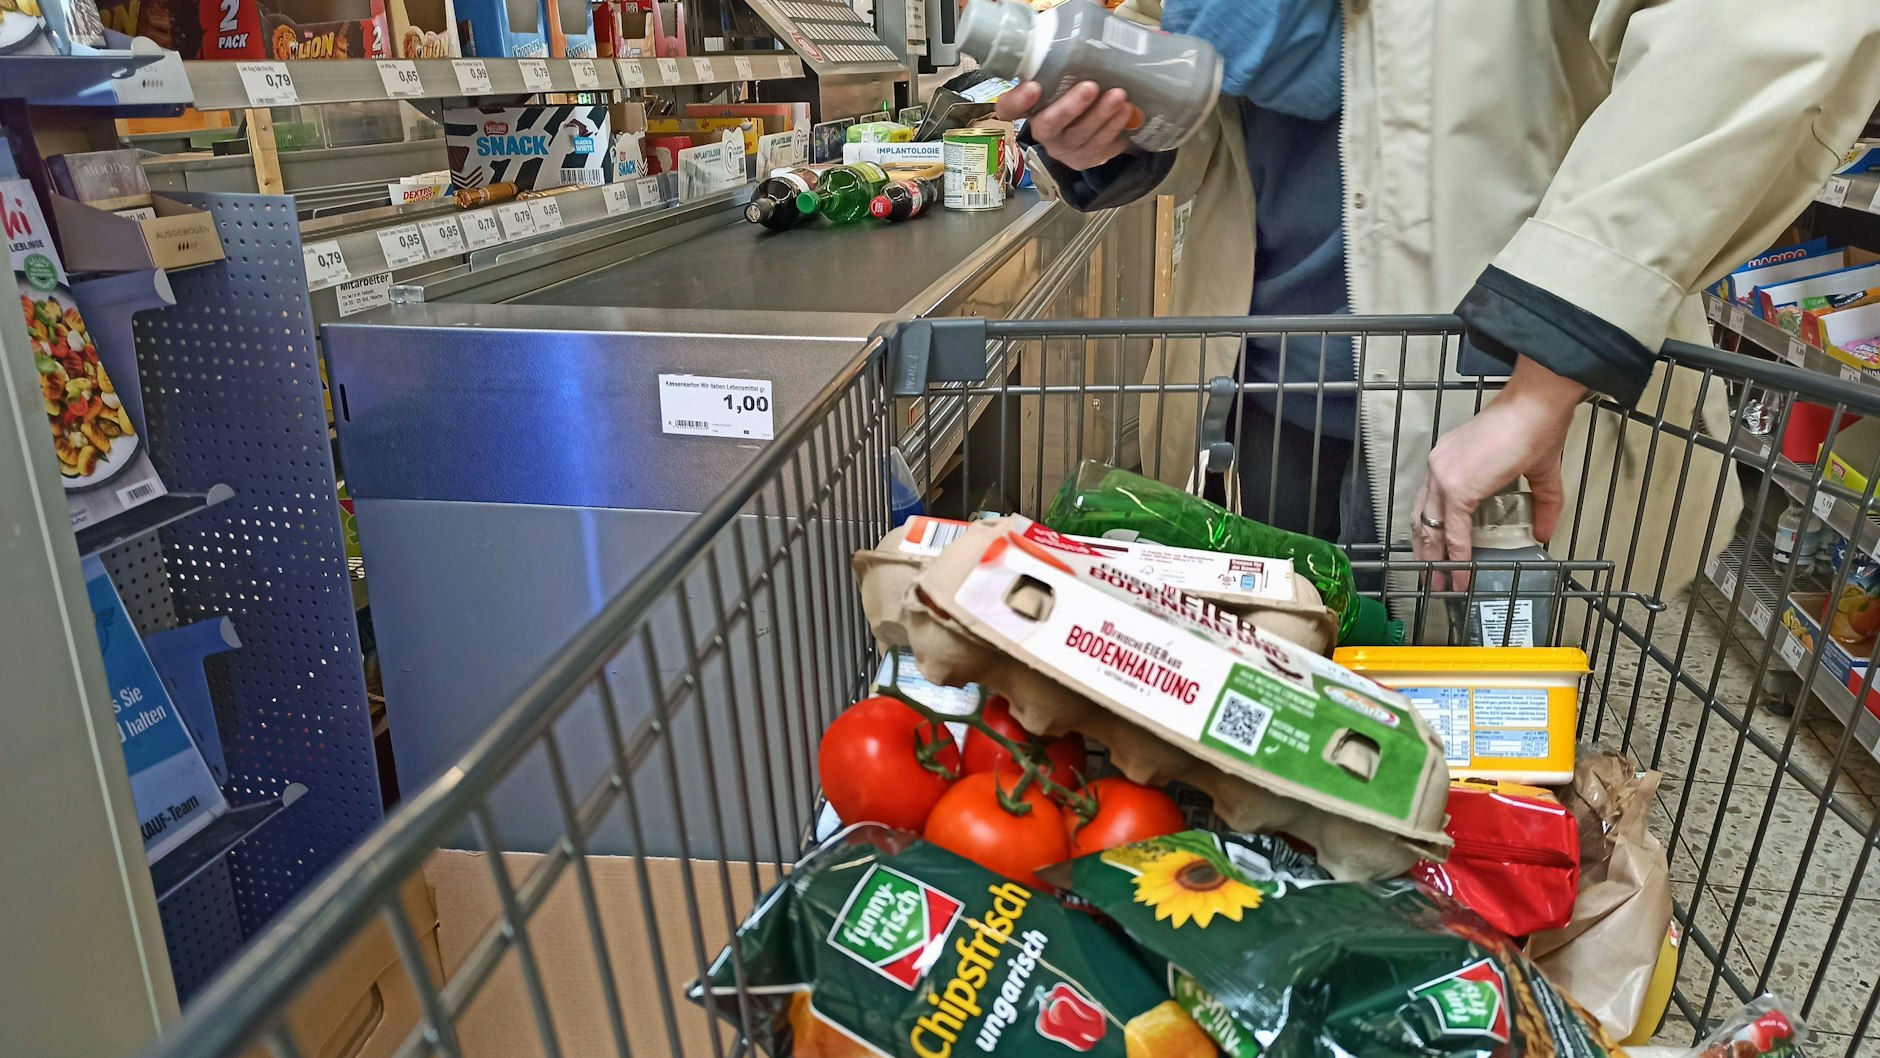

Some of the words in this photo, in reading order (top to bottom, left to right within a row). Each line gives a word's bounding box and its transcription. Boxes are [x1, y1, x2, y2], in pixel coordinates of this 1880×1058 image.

[219, 0, 239, 32] 2
[218, 33, 248, 48] PACK
[299, 32, 335, 58] LION
[371, 26, 383, 51] 2
[398, 70, 418, 84] 0,65
[470, 68, 487, 80] 0,99
[533, 67, 549, 78] 0,79
[583, 66, 596, 77] 0,79
[265, 74, 291, 88] 0,79
[476, 135, 550, 157] SNACK
[83, 162, 131, 176] MOODS
[618, 160, 637, 177] SNACK
[403, 186, 433, 200] DEXTRO
[647, 183, 658, 194] 0,49
[514, 210, 531, 223] 0,79
[543, 203, 558, 216] 0,95
[478, 217, 496, 231] 0,78
[155, 226, 210, 240] AUSGEWOGEN
[439, 226, 459, 240] 0,95
[9, 239, 45, 253] LIEBLINGE
[399, 234, 420, 250] 0,95
[317, 251, 342, 269] 0,79
[726, 384, 759, 392] Lebensmittel
[723, 394, 769, 414] 1,00
[1179, 590, 1257, 636] EIER
[1100, 620, 1115, 636] 10
[1142, 641, 1169, 661] EIER
[1065, 623, 1201, 705] BODENHALTUNG
[120, 685, 144, 707] Sie
[128, 703, 168, 737] halten
[842, 882, 897, 948] funny-
[870, 890, 922, 952] frisch
[909, 880, 1032, 1058] Chipsfrisch
[974, 928, 1049, 1053] ungarisch
